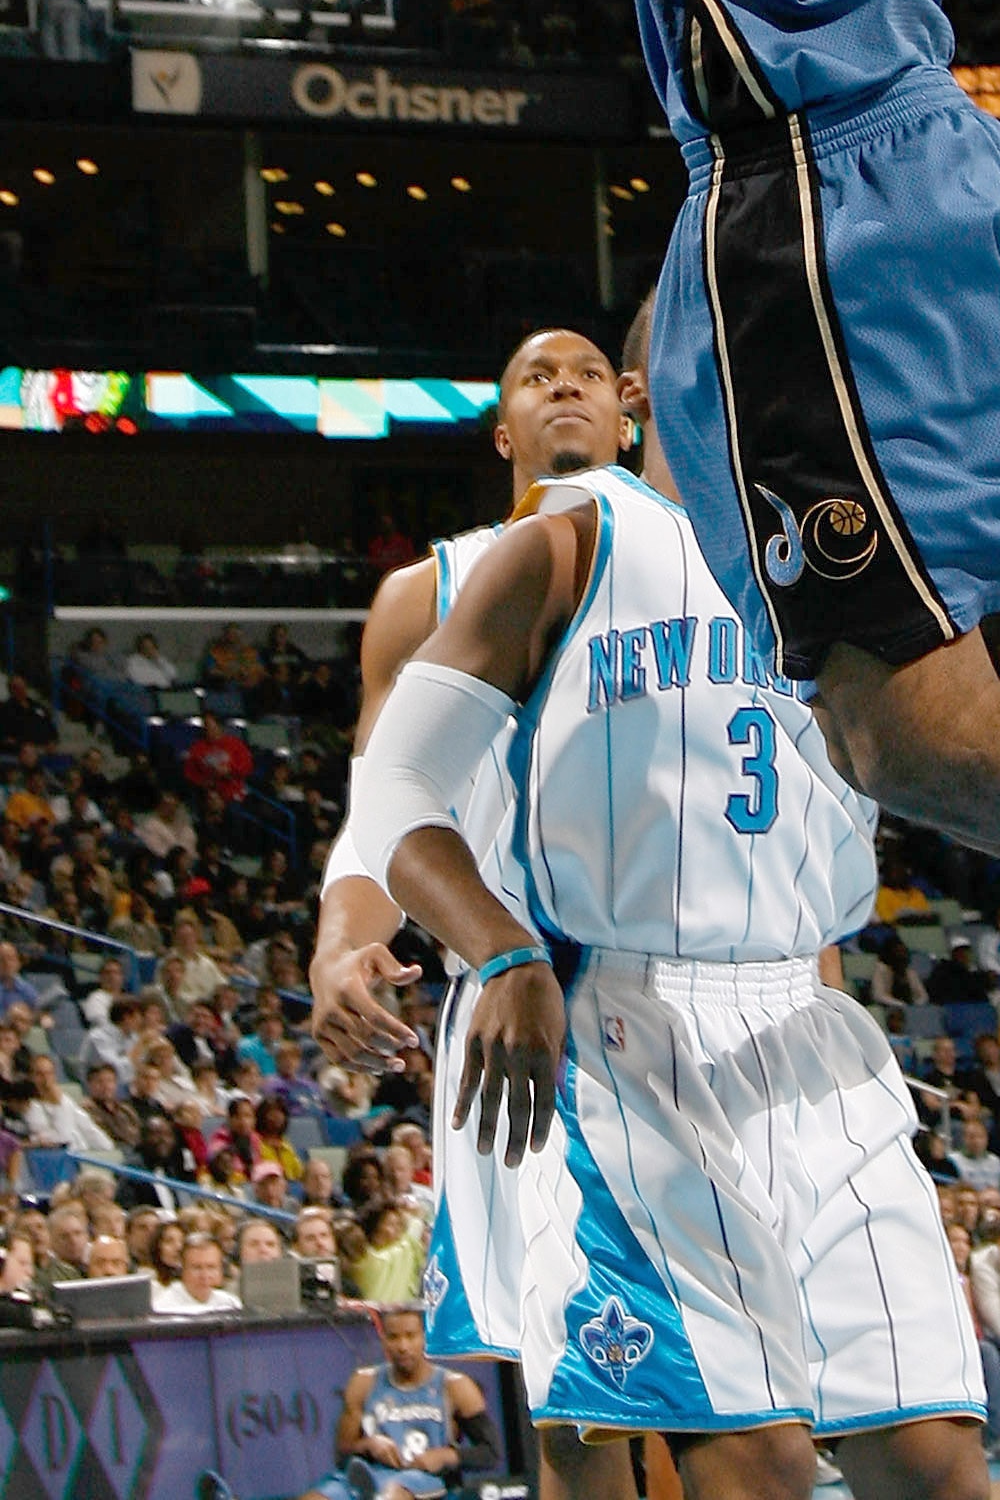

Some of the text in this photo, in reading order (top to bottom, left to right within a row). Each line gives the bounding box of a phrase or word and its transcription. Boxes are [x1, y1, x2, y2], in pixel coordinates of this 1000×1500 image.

[292, 62, 529, 125] Ochsner
[587, 615, 699, 713] NEW
[724, 706, 779, 834] 3
